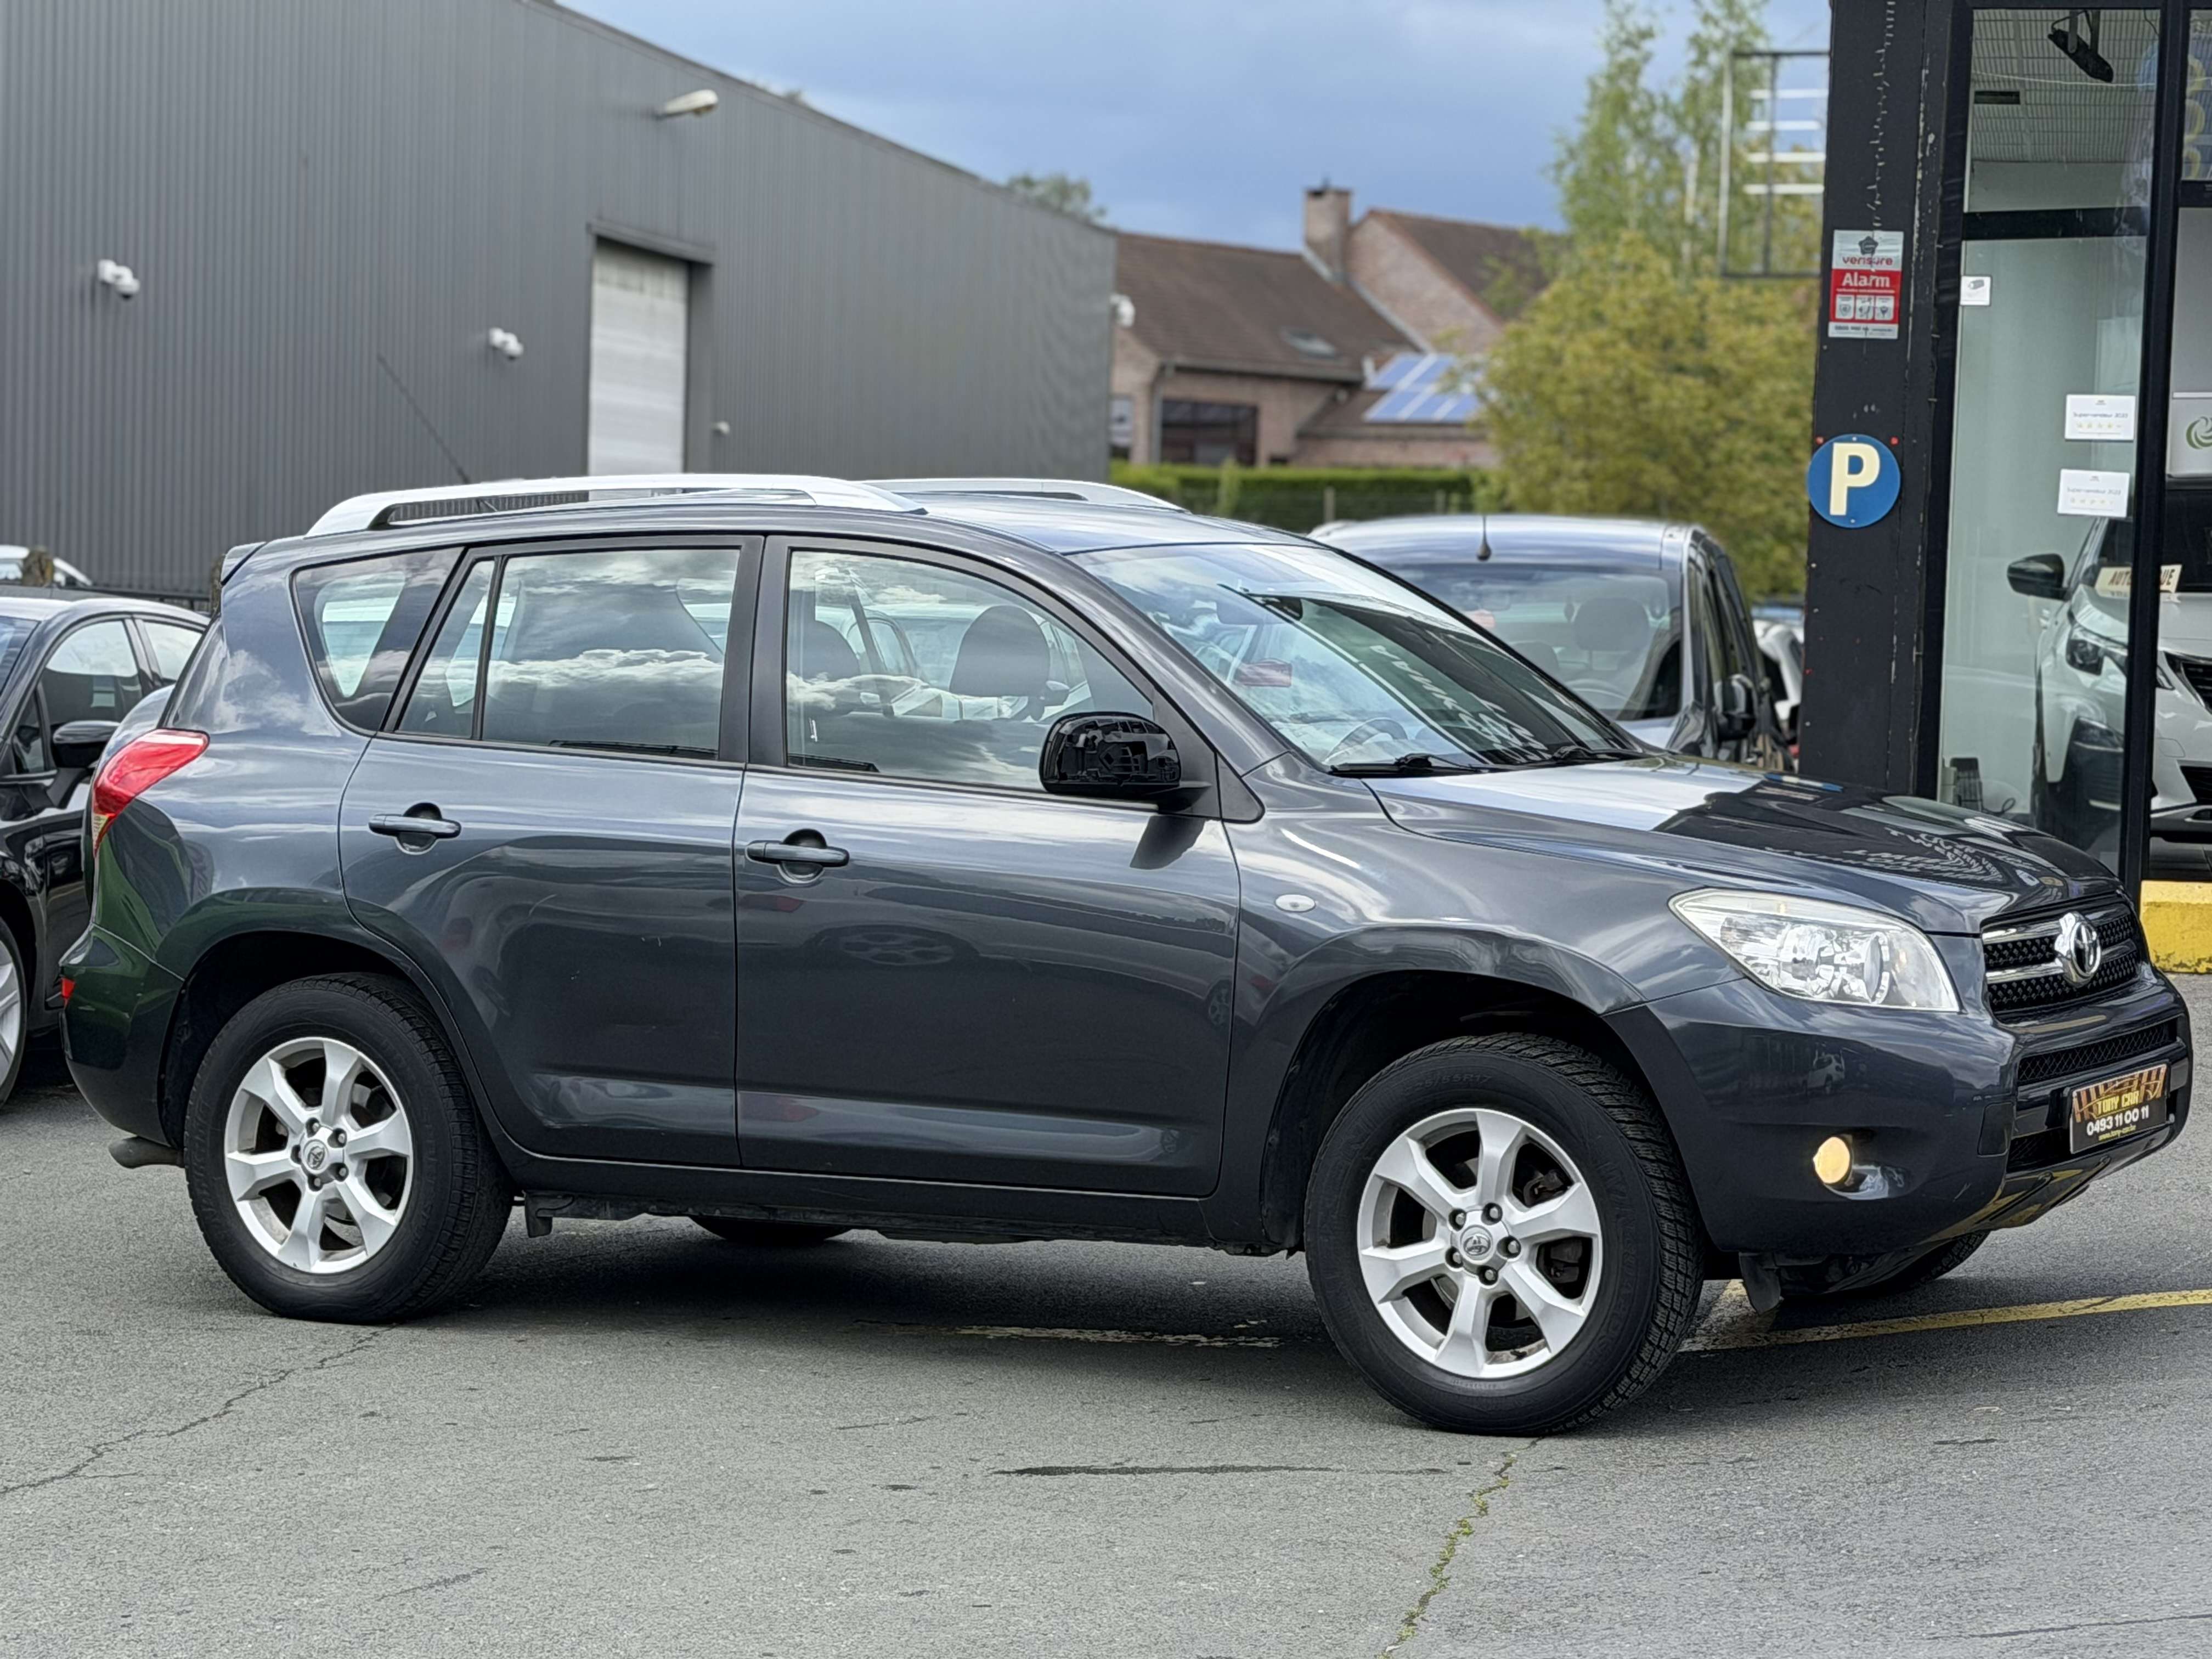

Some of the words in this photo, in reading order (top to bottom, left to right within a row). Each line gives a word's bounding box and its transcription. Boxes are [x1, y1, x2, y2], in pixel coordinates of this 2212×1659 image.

[1842, 256, 1893, 266] verisure
[1842, 272, 1891, 287] Alarm
[1830, 442, 1880, 516] P
[2097, 1096, 2120, 1115] TONY
[2121, 1090, 2140, 1108] CAR
[2086, 1115, 2113, 1136] 0493
[2114, 1113, 2123, 1126] 11
[2124, 1108, 2139, 1124] 00
[2141, 1105, 2149, 1119] 11
